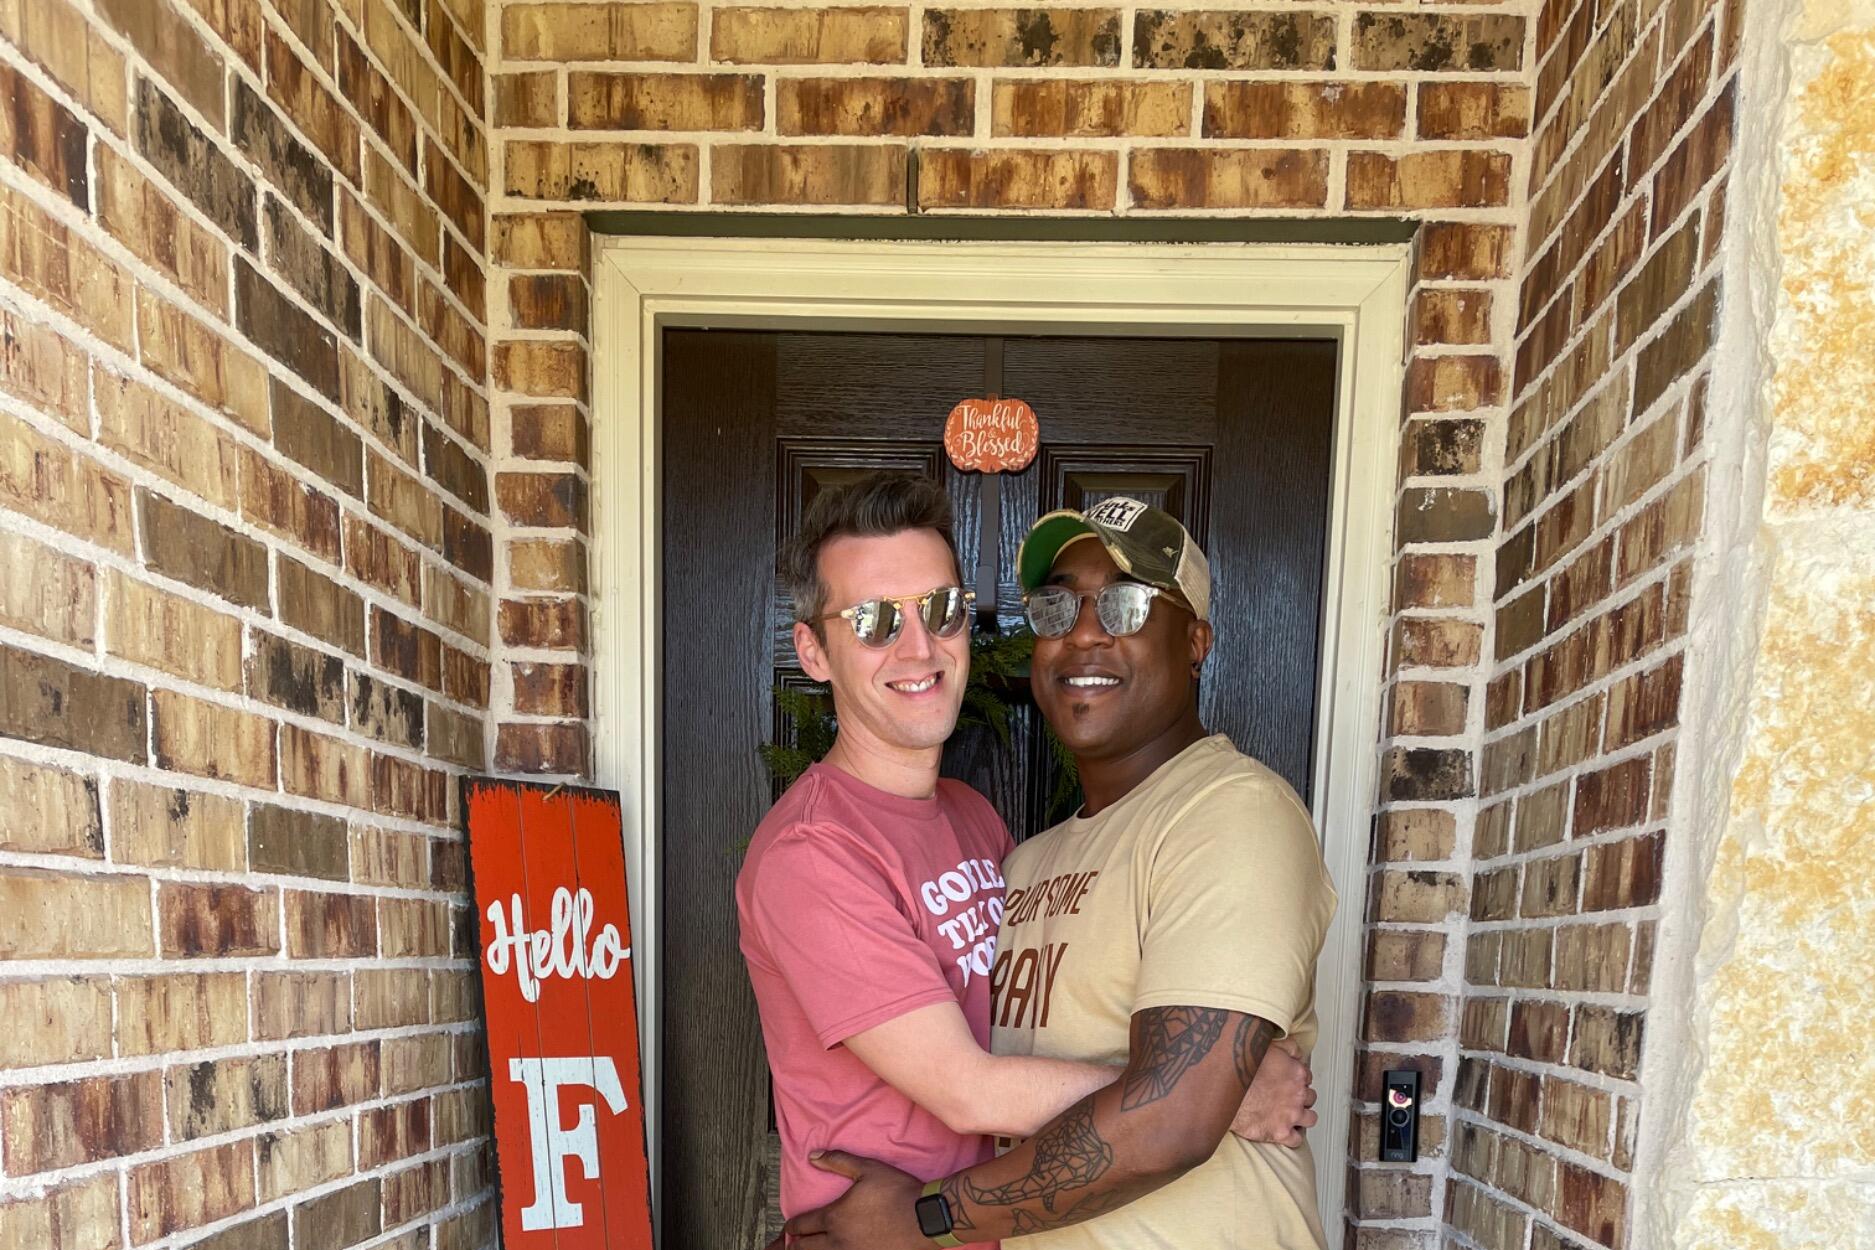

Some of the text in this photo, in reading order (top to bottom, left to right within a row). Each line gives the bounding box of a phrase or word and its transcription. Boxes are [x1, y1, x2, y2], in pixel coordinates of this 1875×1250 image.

[955, 403, 1026, 433] Thankful
[953, 430, 1028, 458] Blessed
[1044, 871, 1099, 918] SOME
[486, 886, 631, 1003] Hello
